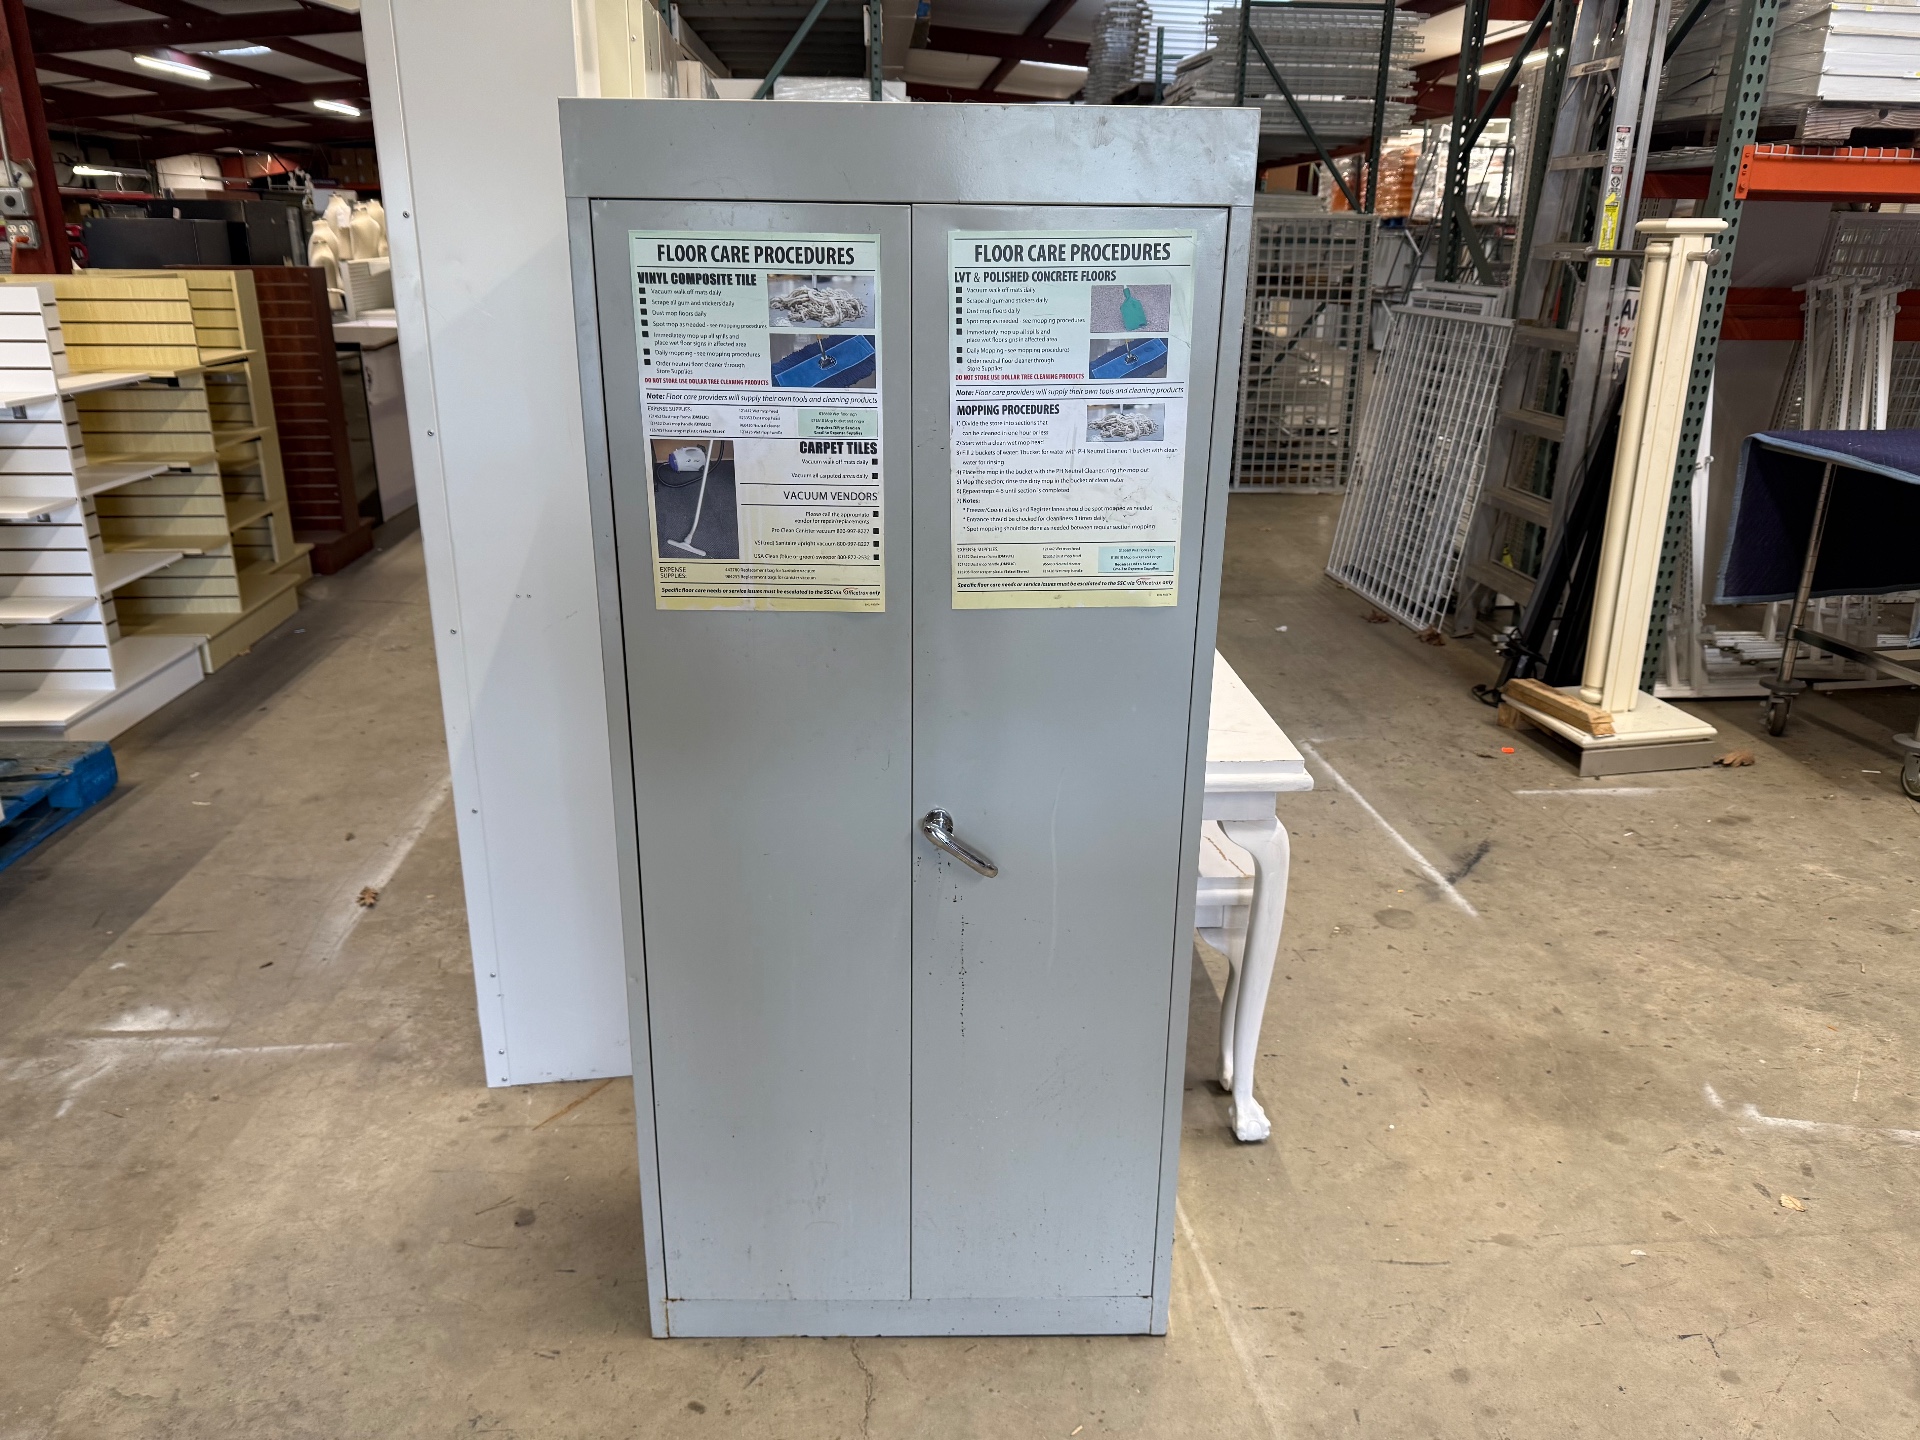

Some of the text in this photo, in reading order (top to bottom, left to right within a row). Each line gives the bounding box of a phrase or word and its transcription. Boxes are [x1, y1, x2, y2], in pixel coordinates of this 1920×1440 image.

[657, 244, 854, 265] FLOOR CARE PROCEDURES
[975, 242, 1171, 263] FLOOR CARE PROCEDURES
[637, 272, 757, 286] VINYL COMPOSITE TILE
[955, 270, 1116, 284] LVT & POLISHED CONCRETE FLOORS
[647, 392, 665, 400] Note:
[698, 394, 727, 402] providers
[741, 394, 761, 403] supply
[822, 396, 849, 405] cleaning
[1006, 389, 1035, 397] providers
[1070, 387, 1083, 395] their
[957, 404, 1060, 416] MOPPING PROCEDURES
[800, 441, 878, 455] CARPET TILES
[784, 491, 878, 501] VACUUM VENDORS
